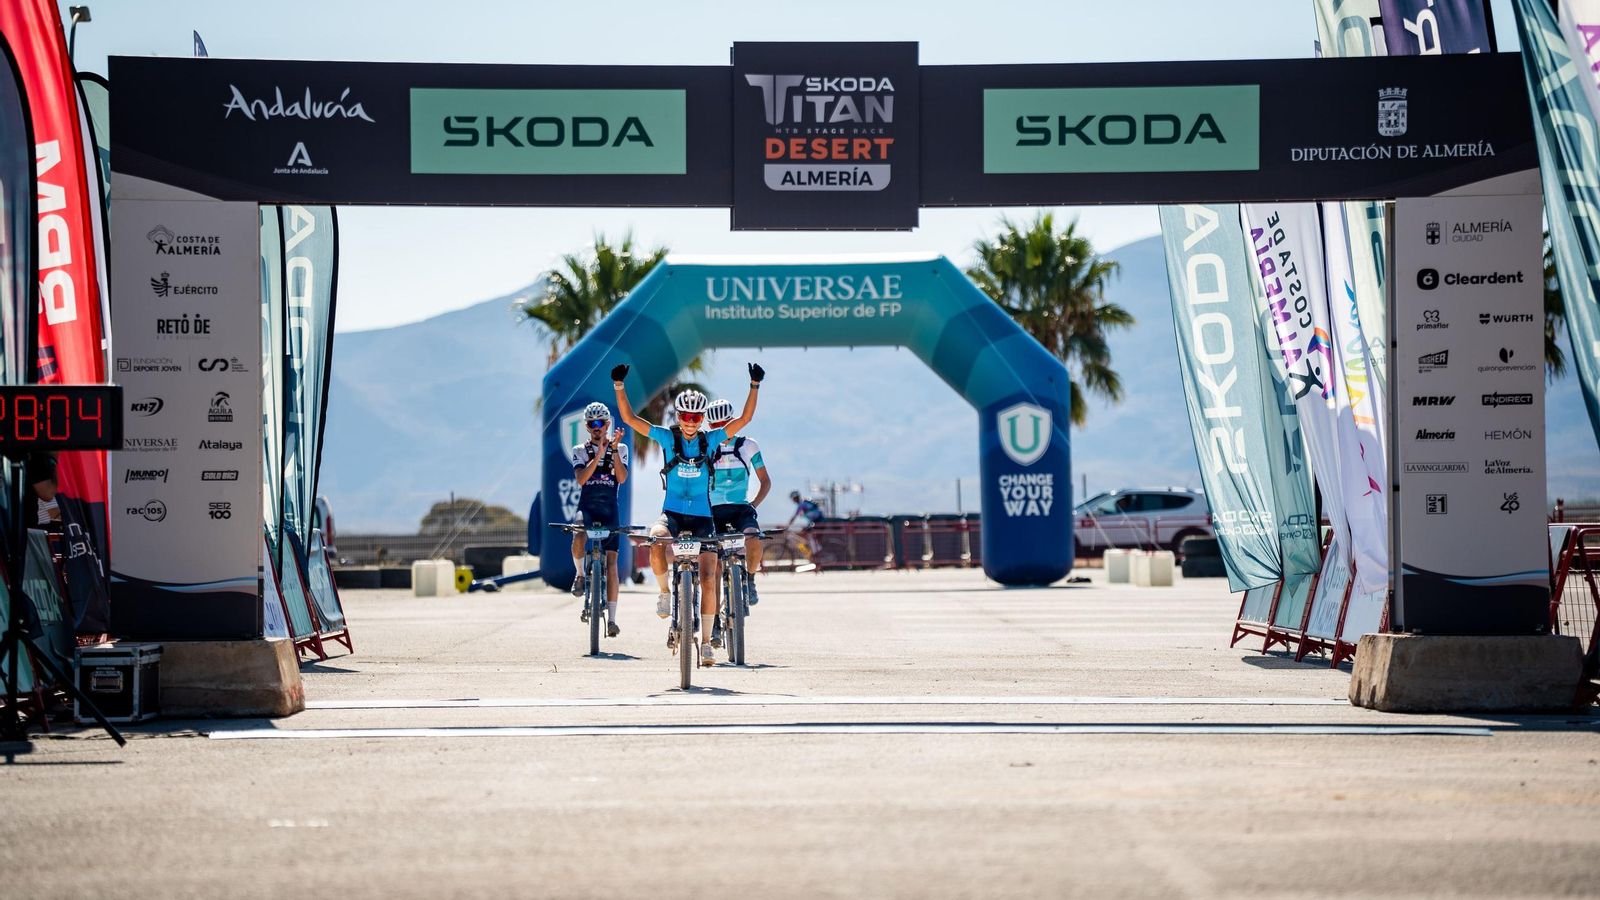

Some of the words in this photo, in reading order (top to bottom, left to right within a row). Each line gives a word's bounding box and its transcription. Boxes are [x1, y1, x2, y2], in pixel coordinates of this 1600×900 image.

[806, 77, 895, 92] SKODA
[223, 84, 376, 123] Andalucía
[744, 74, 894, 126] TITAN
[443, 116, 654, 147] SKODA
[1016, 113, 1227, 146] SKODA
[765, 138, 895, 160] DESERT
[1291, 143, 1392, 162] DIPUTACIÓN
[1398, 144, 1418, 159] DE
[1422, 140, 1495, 158] ALMERÍA
[300, 167, 329, 175] Andalucía
[781, 167, 873, 186] ALMERÍA
[1453, 219, 1513, 234] ALMERÍA
[1452, 234, 1483, 243] CIUDAD
[168, 243, 221, 255] ALMERÍA
[1444, 271, 1524, 286] Cleardent
[174, 284, 218, 295] EJÉRCITO
[705, 275, 904, 302] UNIVERSAE
[705, 303, 774, 320] Instituto
[778, 303, 849, 322] Superior
[853, 302, 875, 318] de
[880, 301, 902, 318] FP
[1416, 322, 1449, 331] primaflor
[1412, 396, 1456, 406] MRW
[1483, 395, 1532, 404] FINDIRECT
[0, 395, 102, 440] 8:04
[1416, 428, 1455, 440] Almería
[1484, 428, 1532, 440] HEMÓN
[124, 438, 178, 447] NIVERSAE
[199, 439, 243, 451] Atalaya
[130, 469, 164, 477] MUNDO
[1406, 464, 1417, 472] LA
[1417, 464, 1467, 472] VANGUARDIA
[998, 473, 1053, 487] CHANGE
[1000, 485, 1053, 501] YOUR
[126, 506, 144, 515] rac
[1003, 500, 1053, 517] WAY
[1428, 496, 1437, 513] RAC
[1438, 496, 1445, 513] 1
[209, 510, 231, 519] 100
[678, 542, 694, 550] 202
